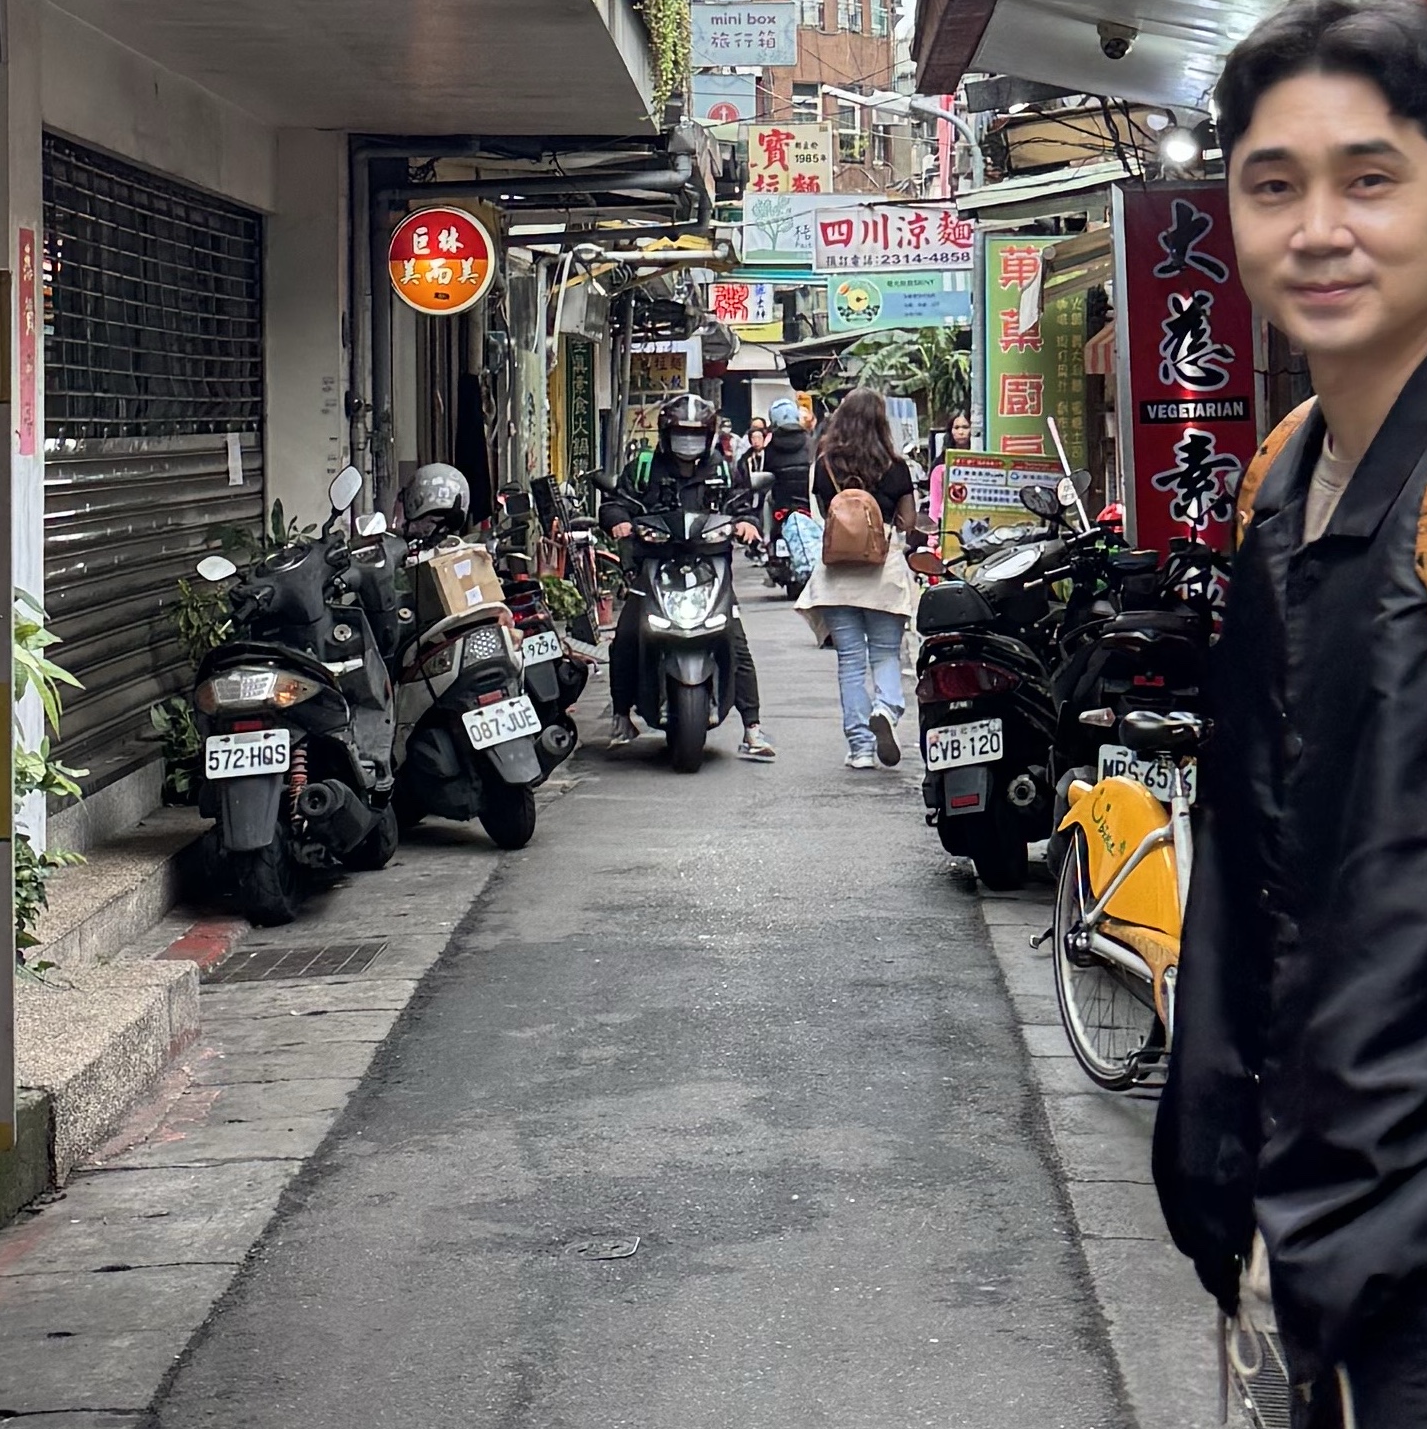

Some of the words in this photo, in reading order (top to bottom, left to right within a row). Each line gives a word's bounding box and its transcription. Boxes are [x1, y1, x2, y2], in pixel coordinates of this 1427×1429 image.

[711, 13, 741, 25] mini
[747, 12, 776, 25] box
[710, 31, 776, 48] 旅行箱
[819, 211, 972, 251] 四川涼麵
[1146, 400, 1244, 420] VEGETARIAN
